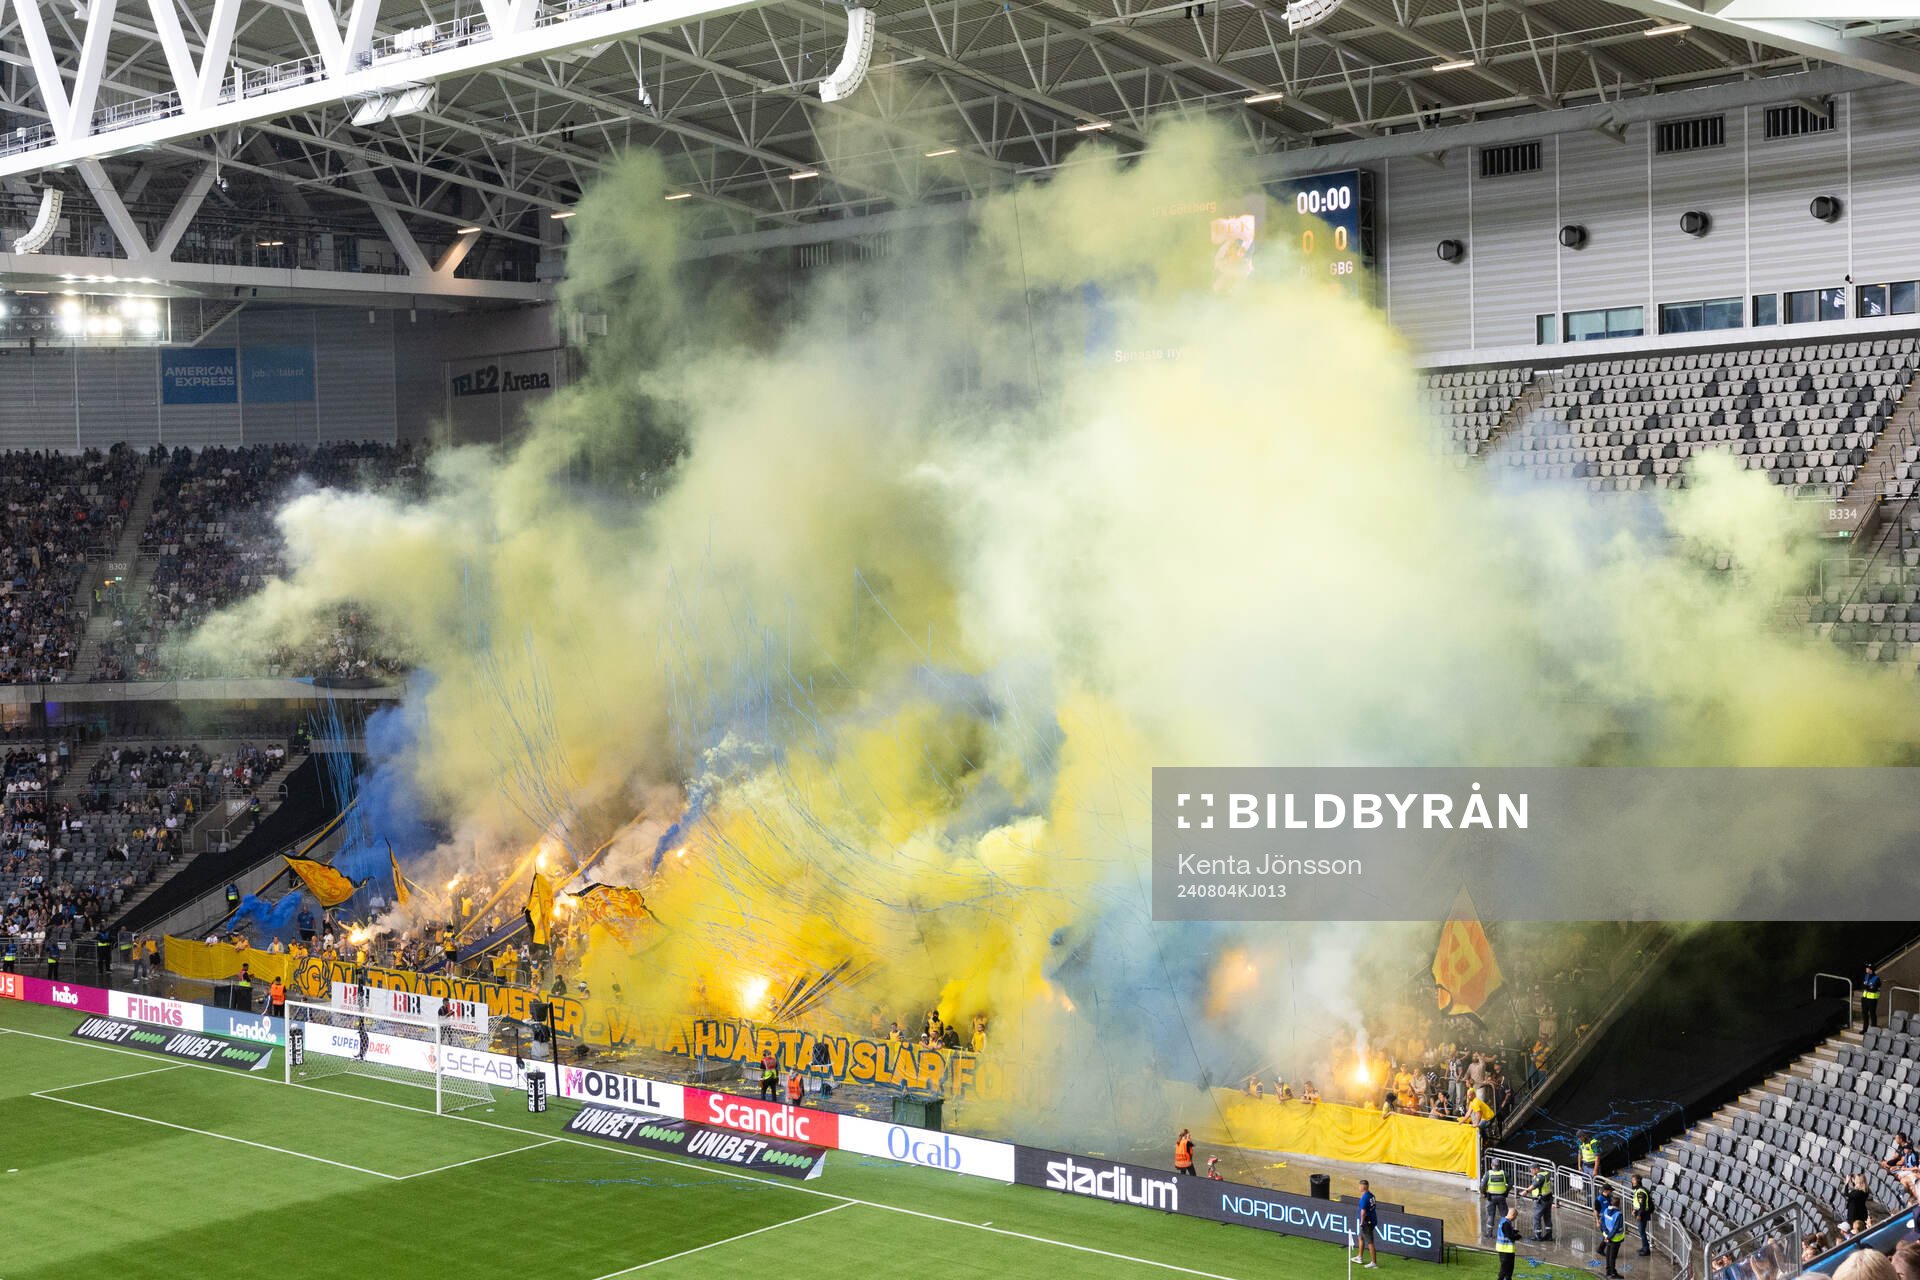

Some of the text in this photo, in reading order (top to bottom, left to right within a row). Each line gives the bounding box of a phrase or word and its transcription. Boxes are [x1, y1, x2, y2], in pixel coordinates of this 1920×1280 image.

[1297, 186, 1350, 214] 00:00
[1335, 226, 1347, 251] 0
[1330, 261, 1353, 275] GBG
[165, 366, 234, 376] AMERICAN
[175, 376, 236, 387] EXPRESS
[452, 365, 550, 397] TELE2 Arena
[1829, 508, 1857, 520] B334
[52, 985, 78, 1005] habo
[127, 997, 183, 1027] Flinks
[77, 1017, 229, 1060] UNIBET UNIBET
[331, 1035, 359, 1050] SUPER
[446, 1053, 514, 1081] SEFAB
[528, 1079, 536, 1112] SELECT
[538, 1079, 546, 1112] SELECT
[564, 1067, 660, 1108] MOBILL
[708, 1094, 810, 1140] Scandic
[571, 1107, 769, 1164] UNIBET UNIBET
[887, 1126, 961, 1170] Ocab
[1046, 1158, 1178, 1211] stadium
